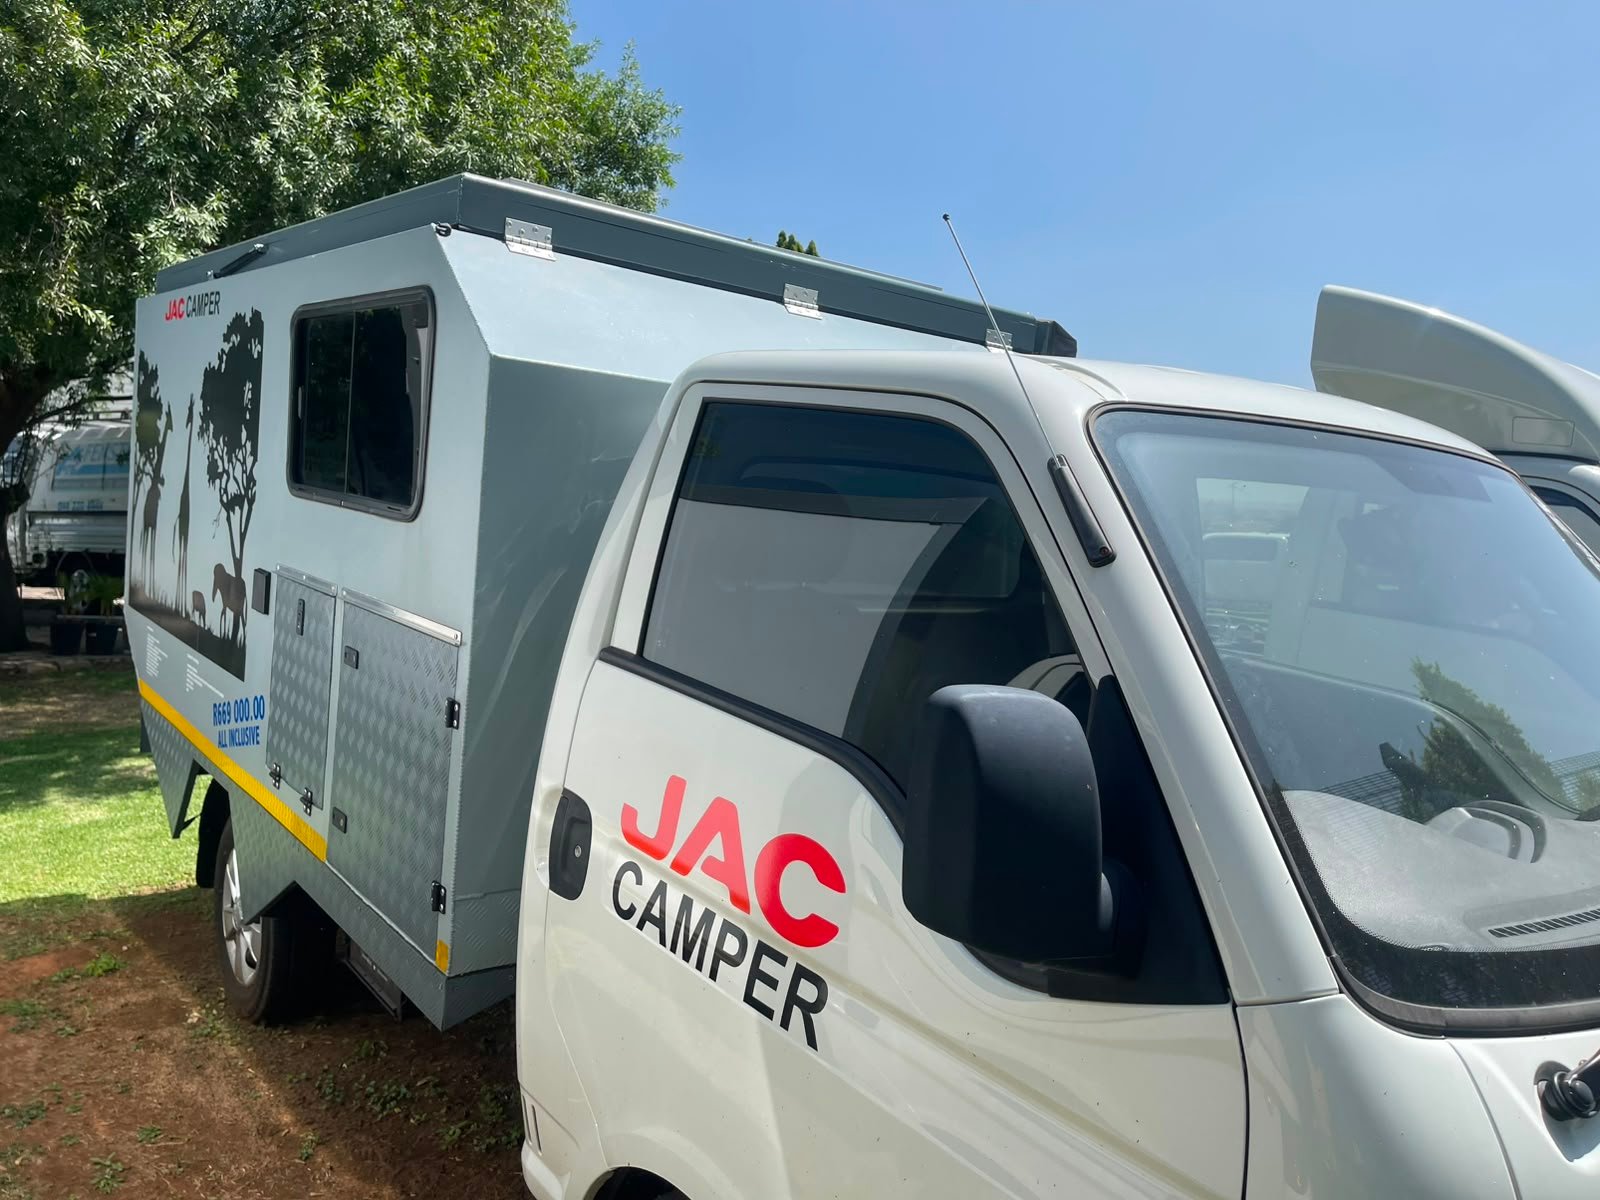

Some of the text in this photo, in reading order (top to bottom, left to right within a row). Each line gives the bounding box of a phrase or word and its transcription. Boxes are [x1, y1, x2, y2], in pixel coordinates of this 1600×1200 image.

[165, 291, 221, 321] JAC CAMPER
[213, 695, 265, 726] R669 000.00
[218, 725, 260, 748] ALL INCLUSIVE
[621, 774, 847, 948] JAC
[612, 861, 829, 1052] CAMPER
